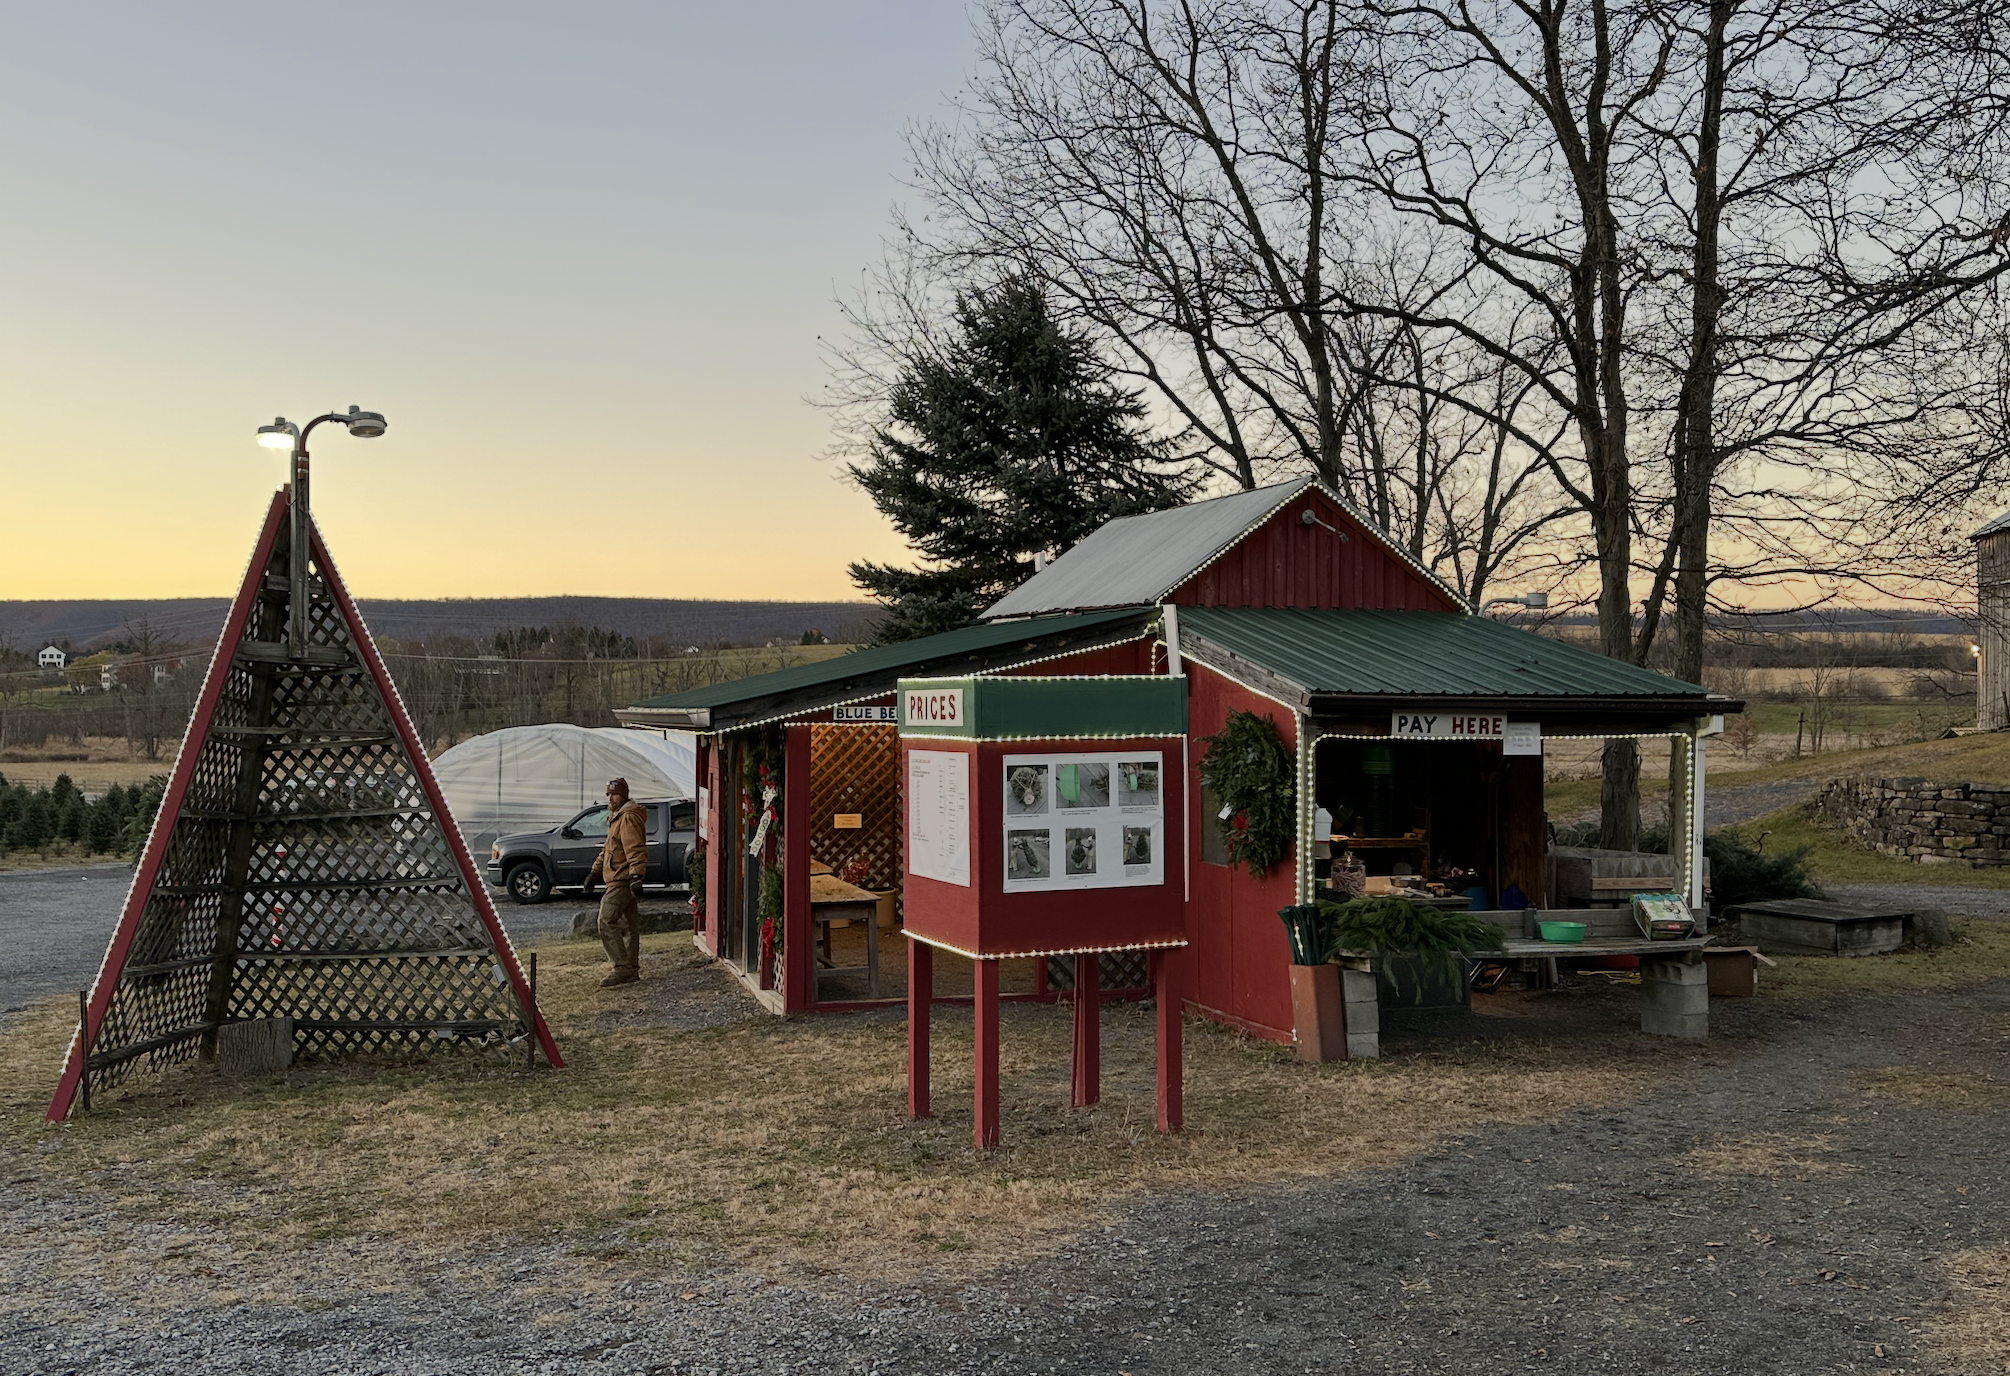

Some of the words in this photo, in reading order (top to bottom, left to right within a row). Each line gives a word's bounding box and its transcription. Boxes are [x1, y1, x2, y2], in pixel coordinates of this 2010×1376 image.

[836, 707, 873, 719] BLUE
[880, 707, 898, 719] BE
[910, 694, 957, 721] PRICES
[1397, 715, 1438, 734] PAY
[1451, 716, 1503, 735] HERE
